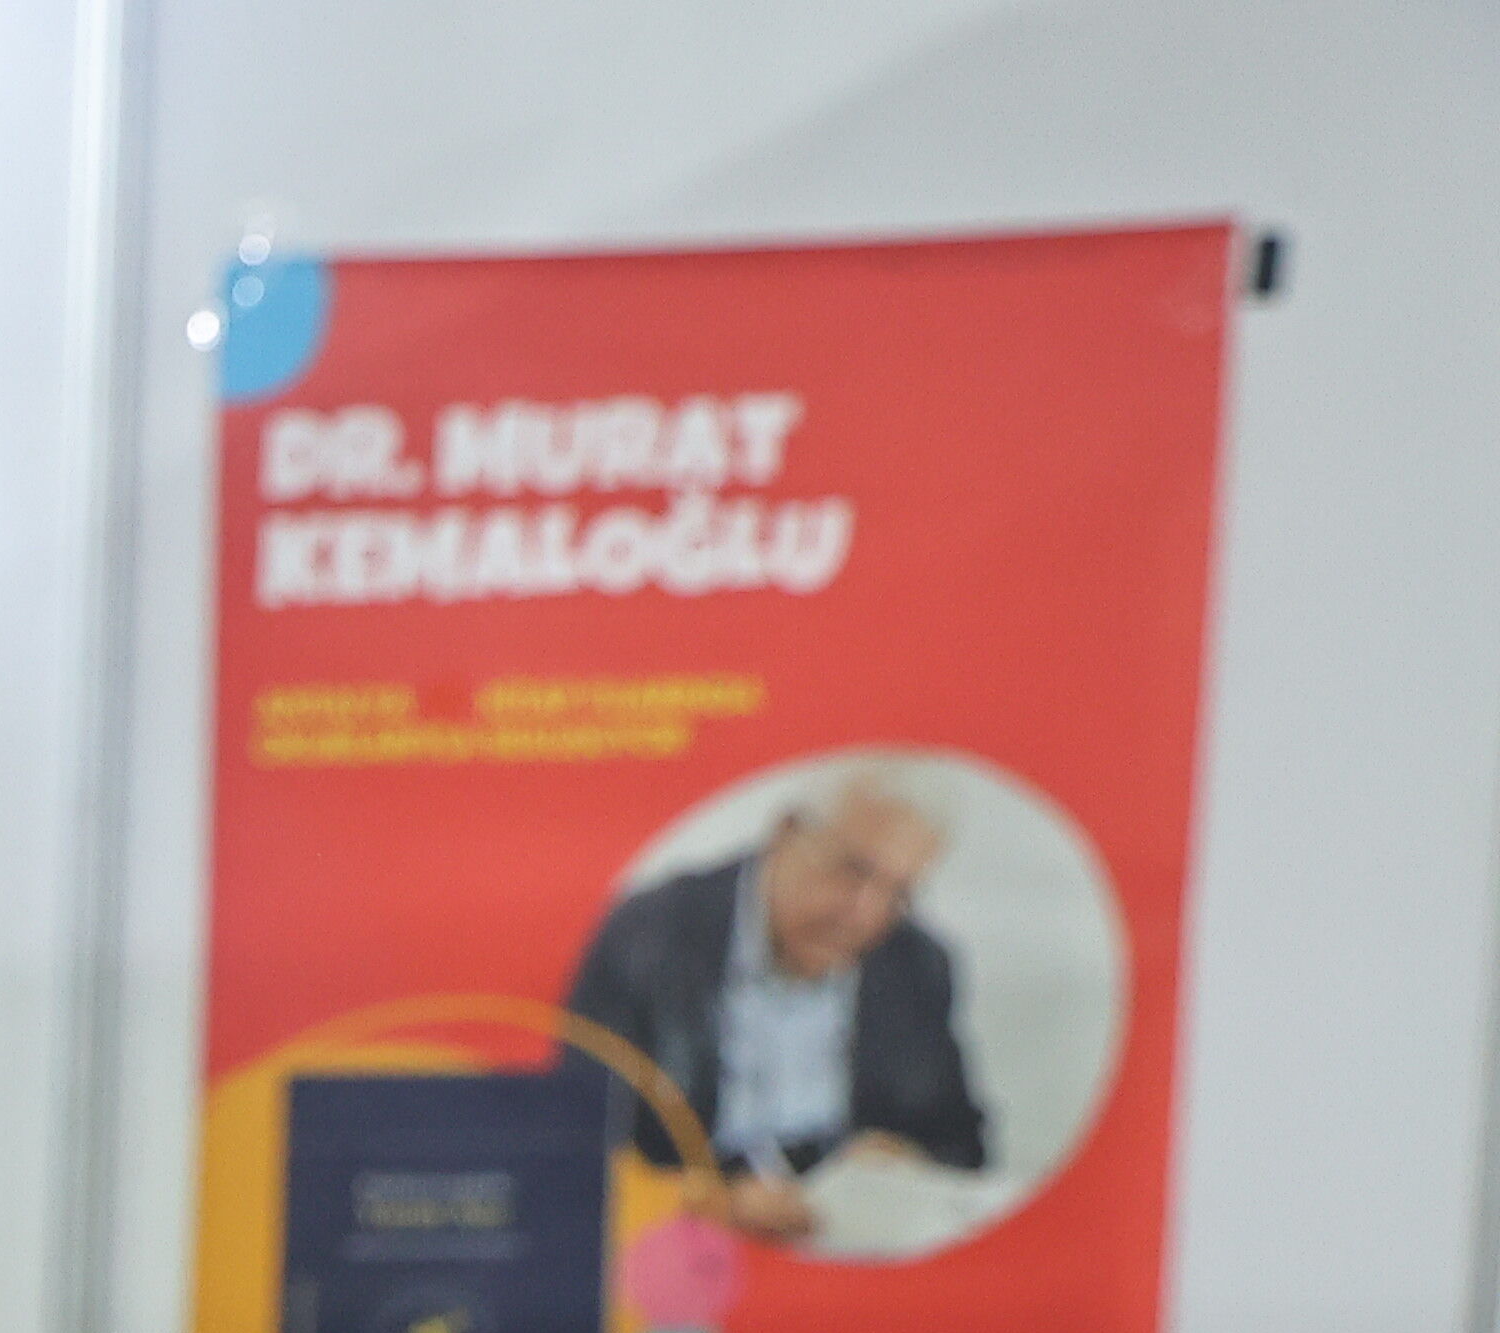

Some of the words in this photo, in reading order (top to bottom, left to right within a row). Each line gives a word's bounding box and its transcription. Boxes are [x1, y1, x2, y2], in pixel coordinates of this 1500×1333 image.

[260, 404, 423, 500] DR.
[434, 392, 802, 496] MURAT
[257, 484, 853, 609] KEMALOĞLU
